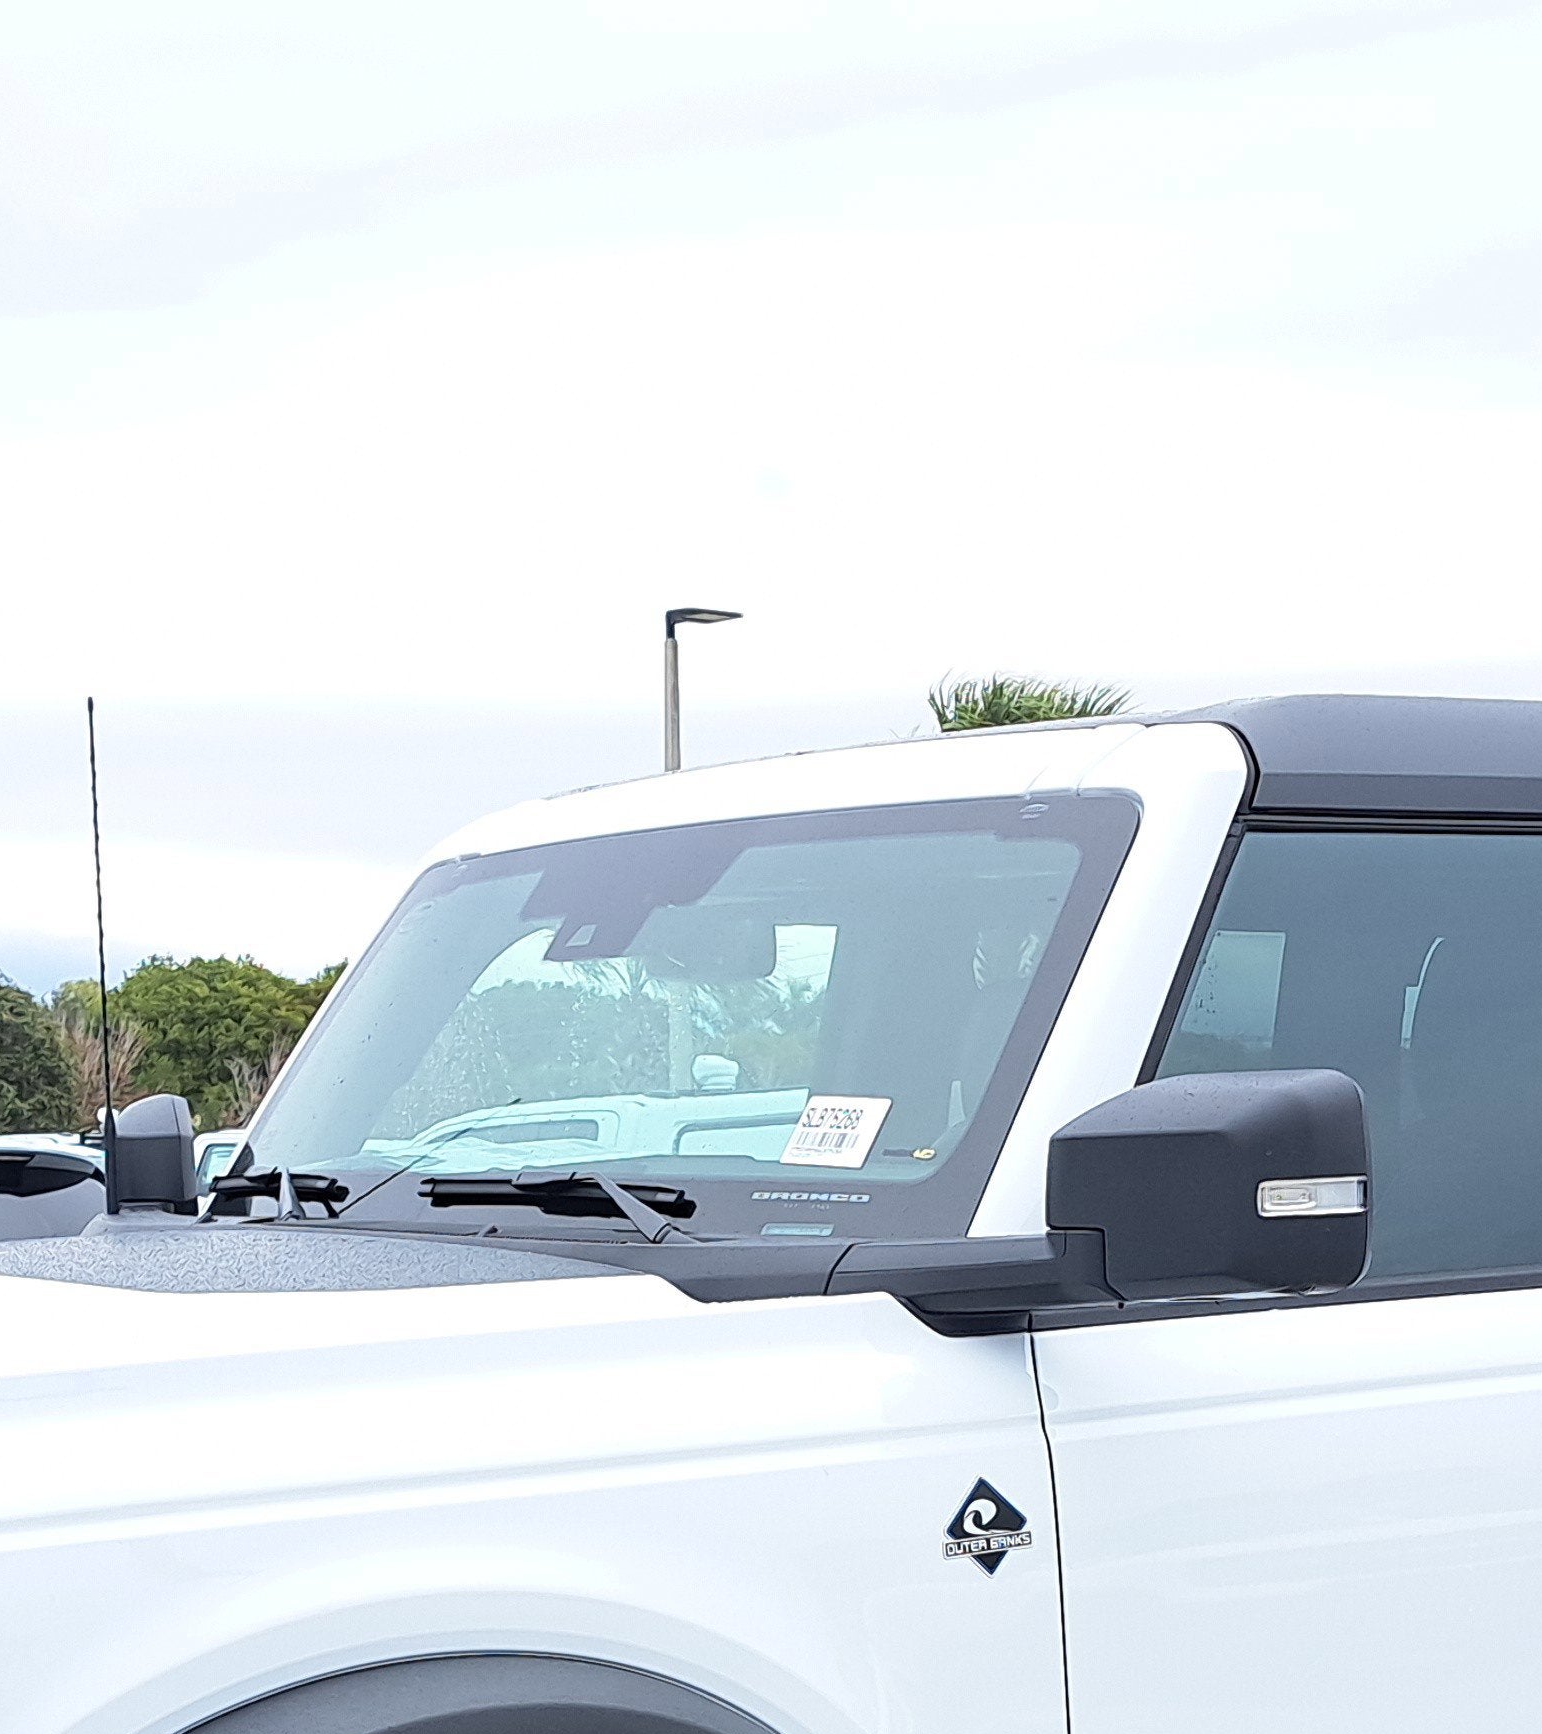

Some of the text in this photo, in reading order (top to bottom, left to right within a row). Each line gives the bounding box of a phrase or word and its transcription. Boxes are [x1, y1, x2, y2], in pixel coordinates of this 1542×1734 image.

[751, 1191, 871, 1203] BRONCO
[946, 1533, 1031, 1556] OUTER BANKS
